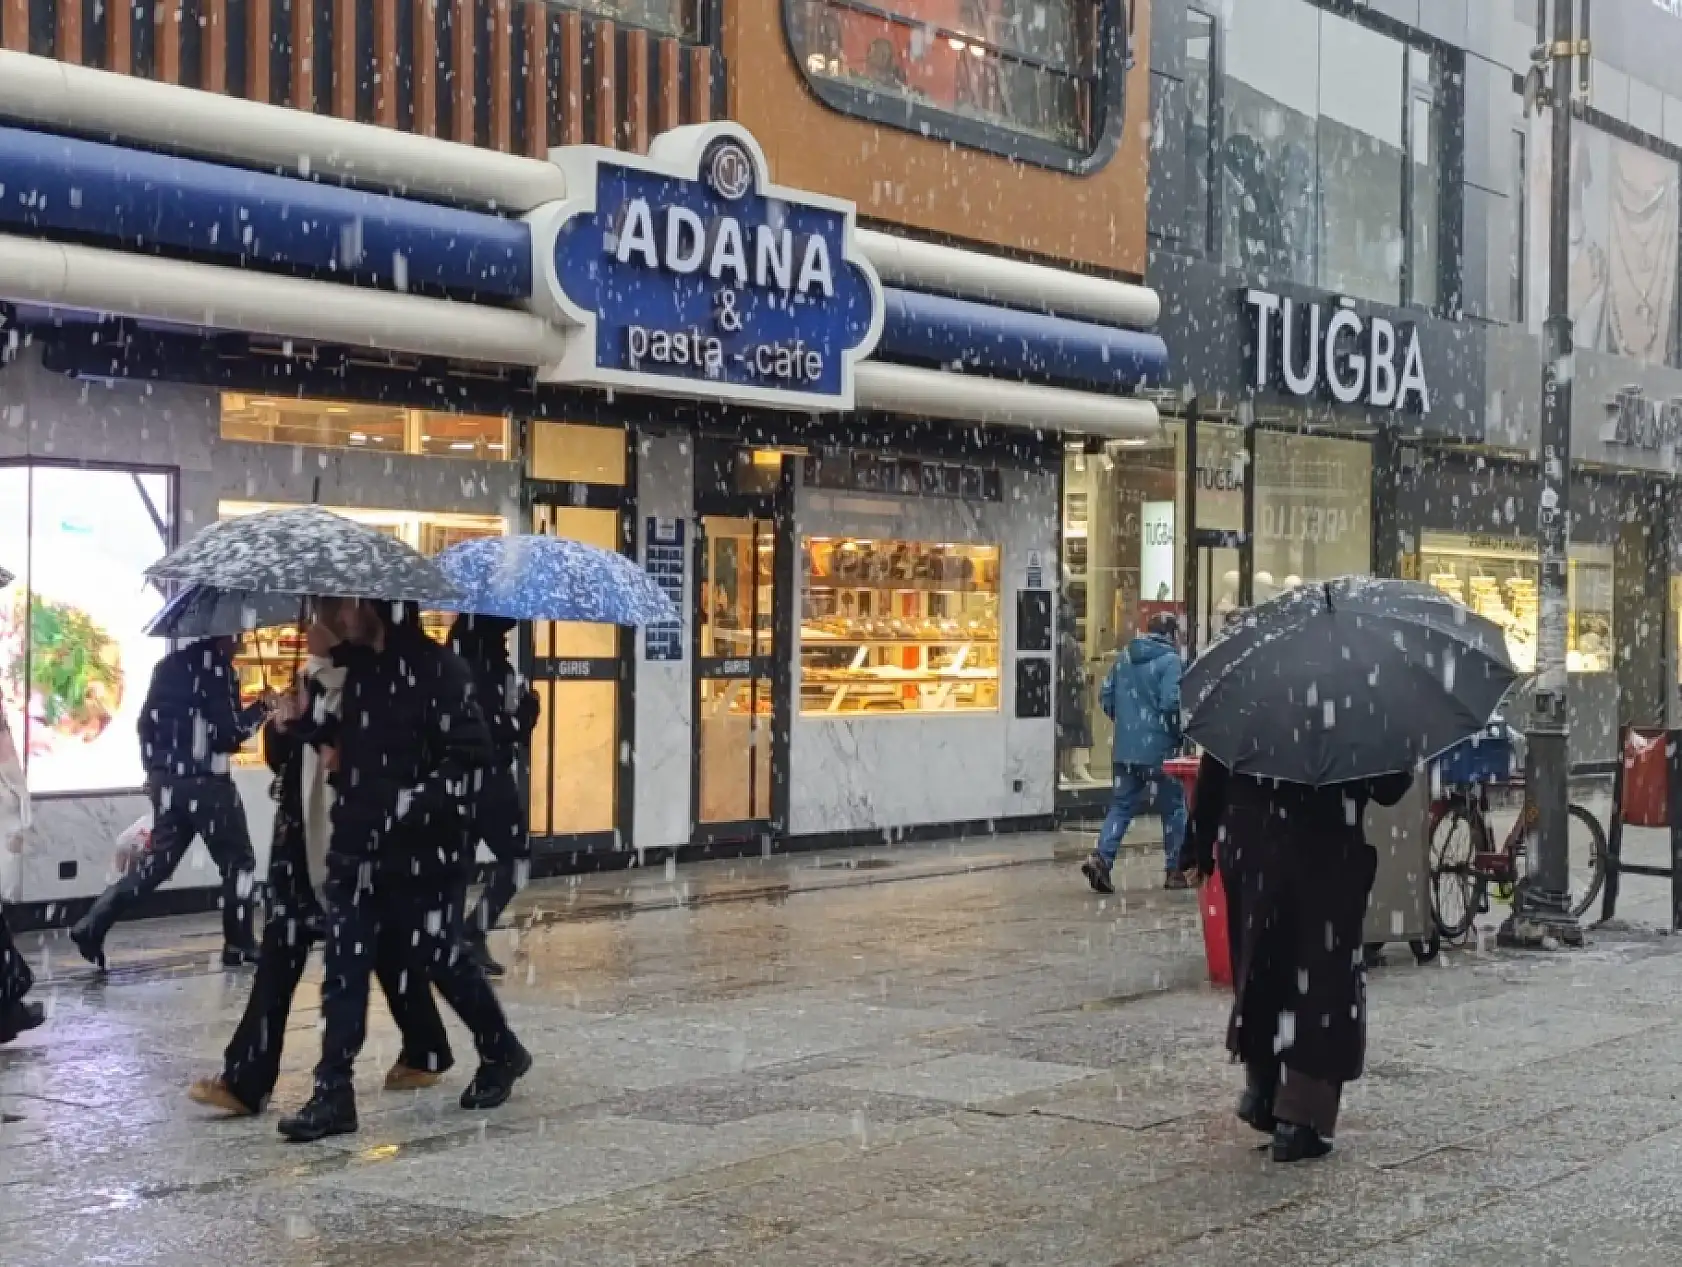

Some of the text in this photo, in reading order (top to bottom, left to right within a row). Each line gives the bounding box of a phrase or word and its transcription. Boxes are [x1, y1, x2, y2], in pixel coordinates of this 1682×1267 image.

[616, 197, 835, 298] ADANA
[718, 288, 744, 331] &
[628, 324, 724, 370] pasta
[756, 339, 823, 381] cafe
[1247, 289, 1431, 413] TUĞBA
